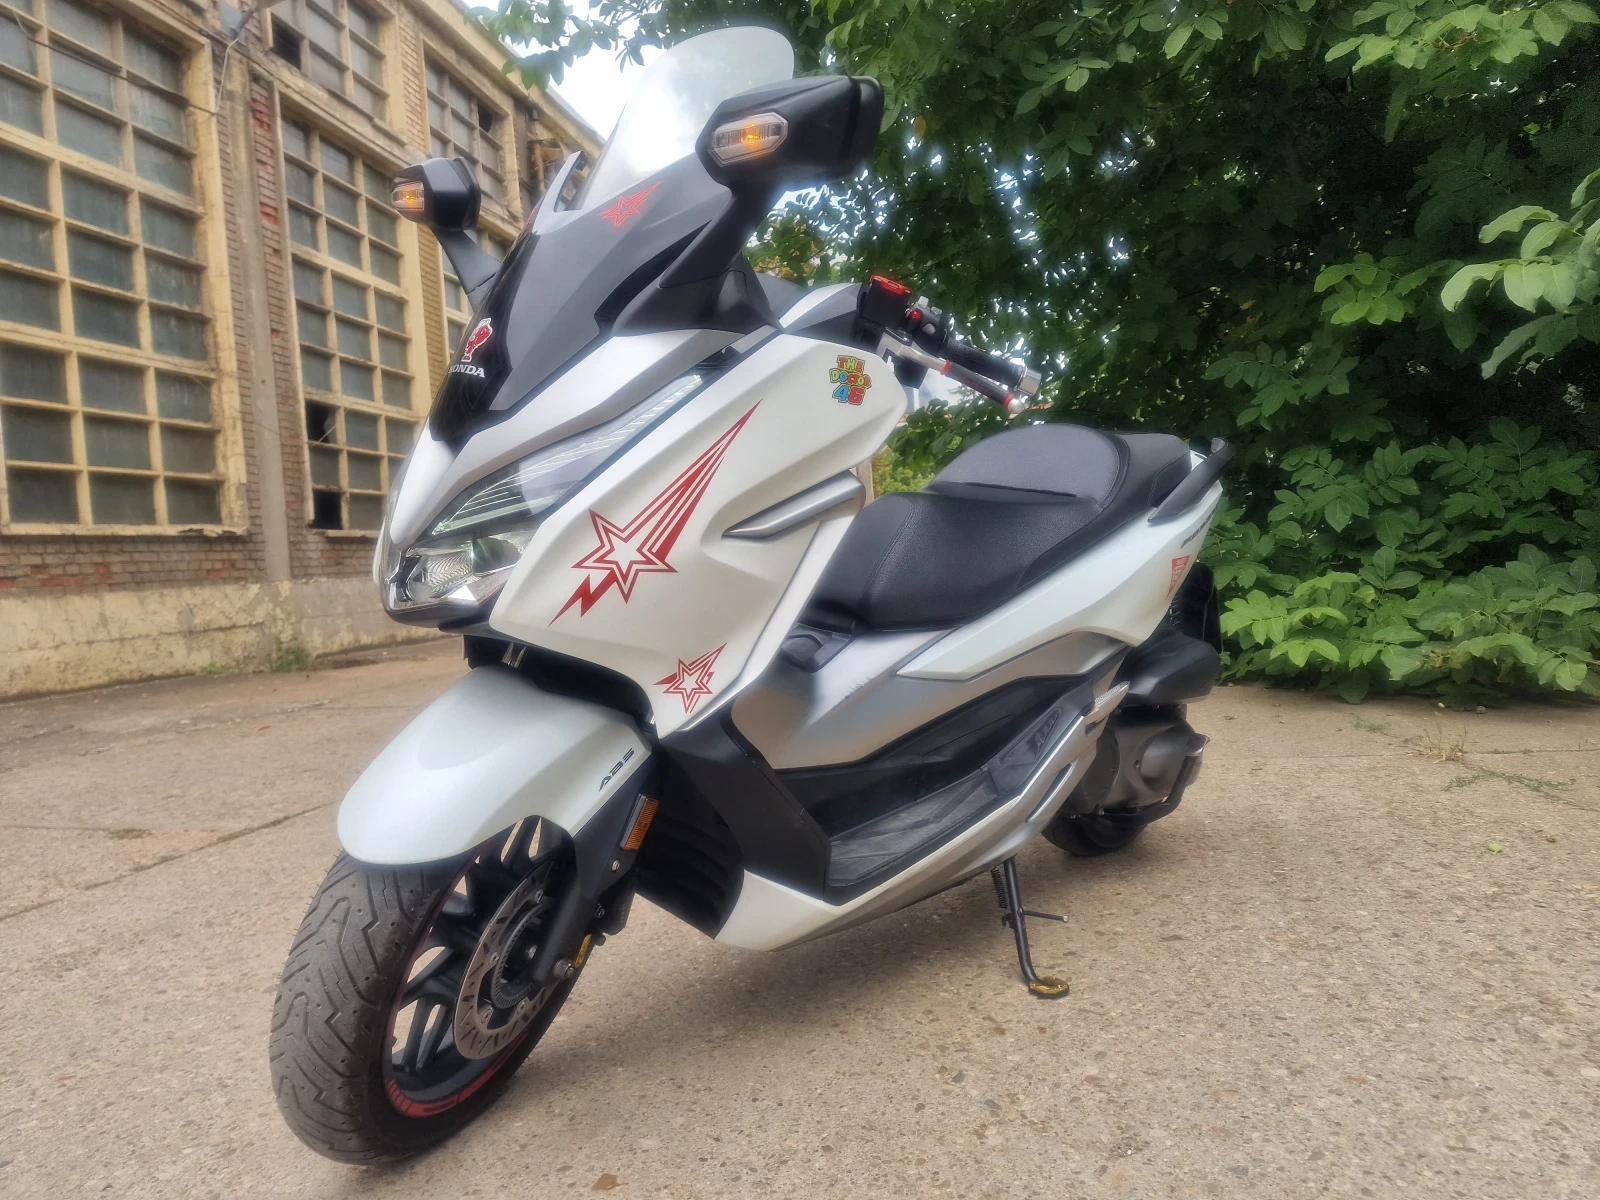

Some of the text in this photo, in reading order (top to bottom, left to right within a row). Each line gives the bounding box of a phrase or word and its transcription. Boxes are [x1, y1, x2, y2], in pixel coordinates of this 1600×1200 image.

[838, 356, 865, 373] THE
[833, 384, 865, 405] 46
[599, 748, 635, 792] ABS
